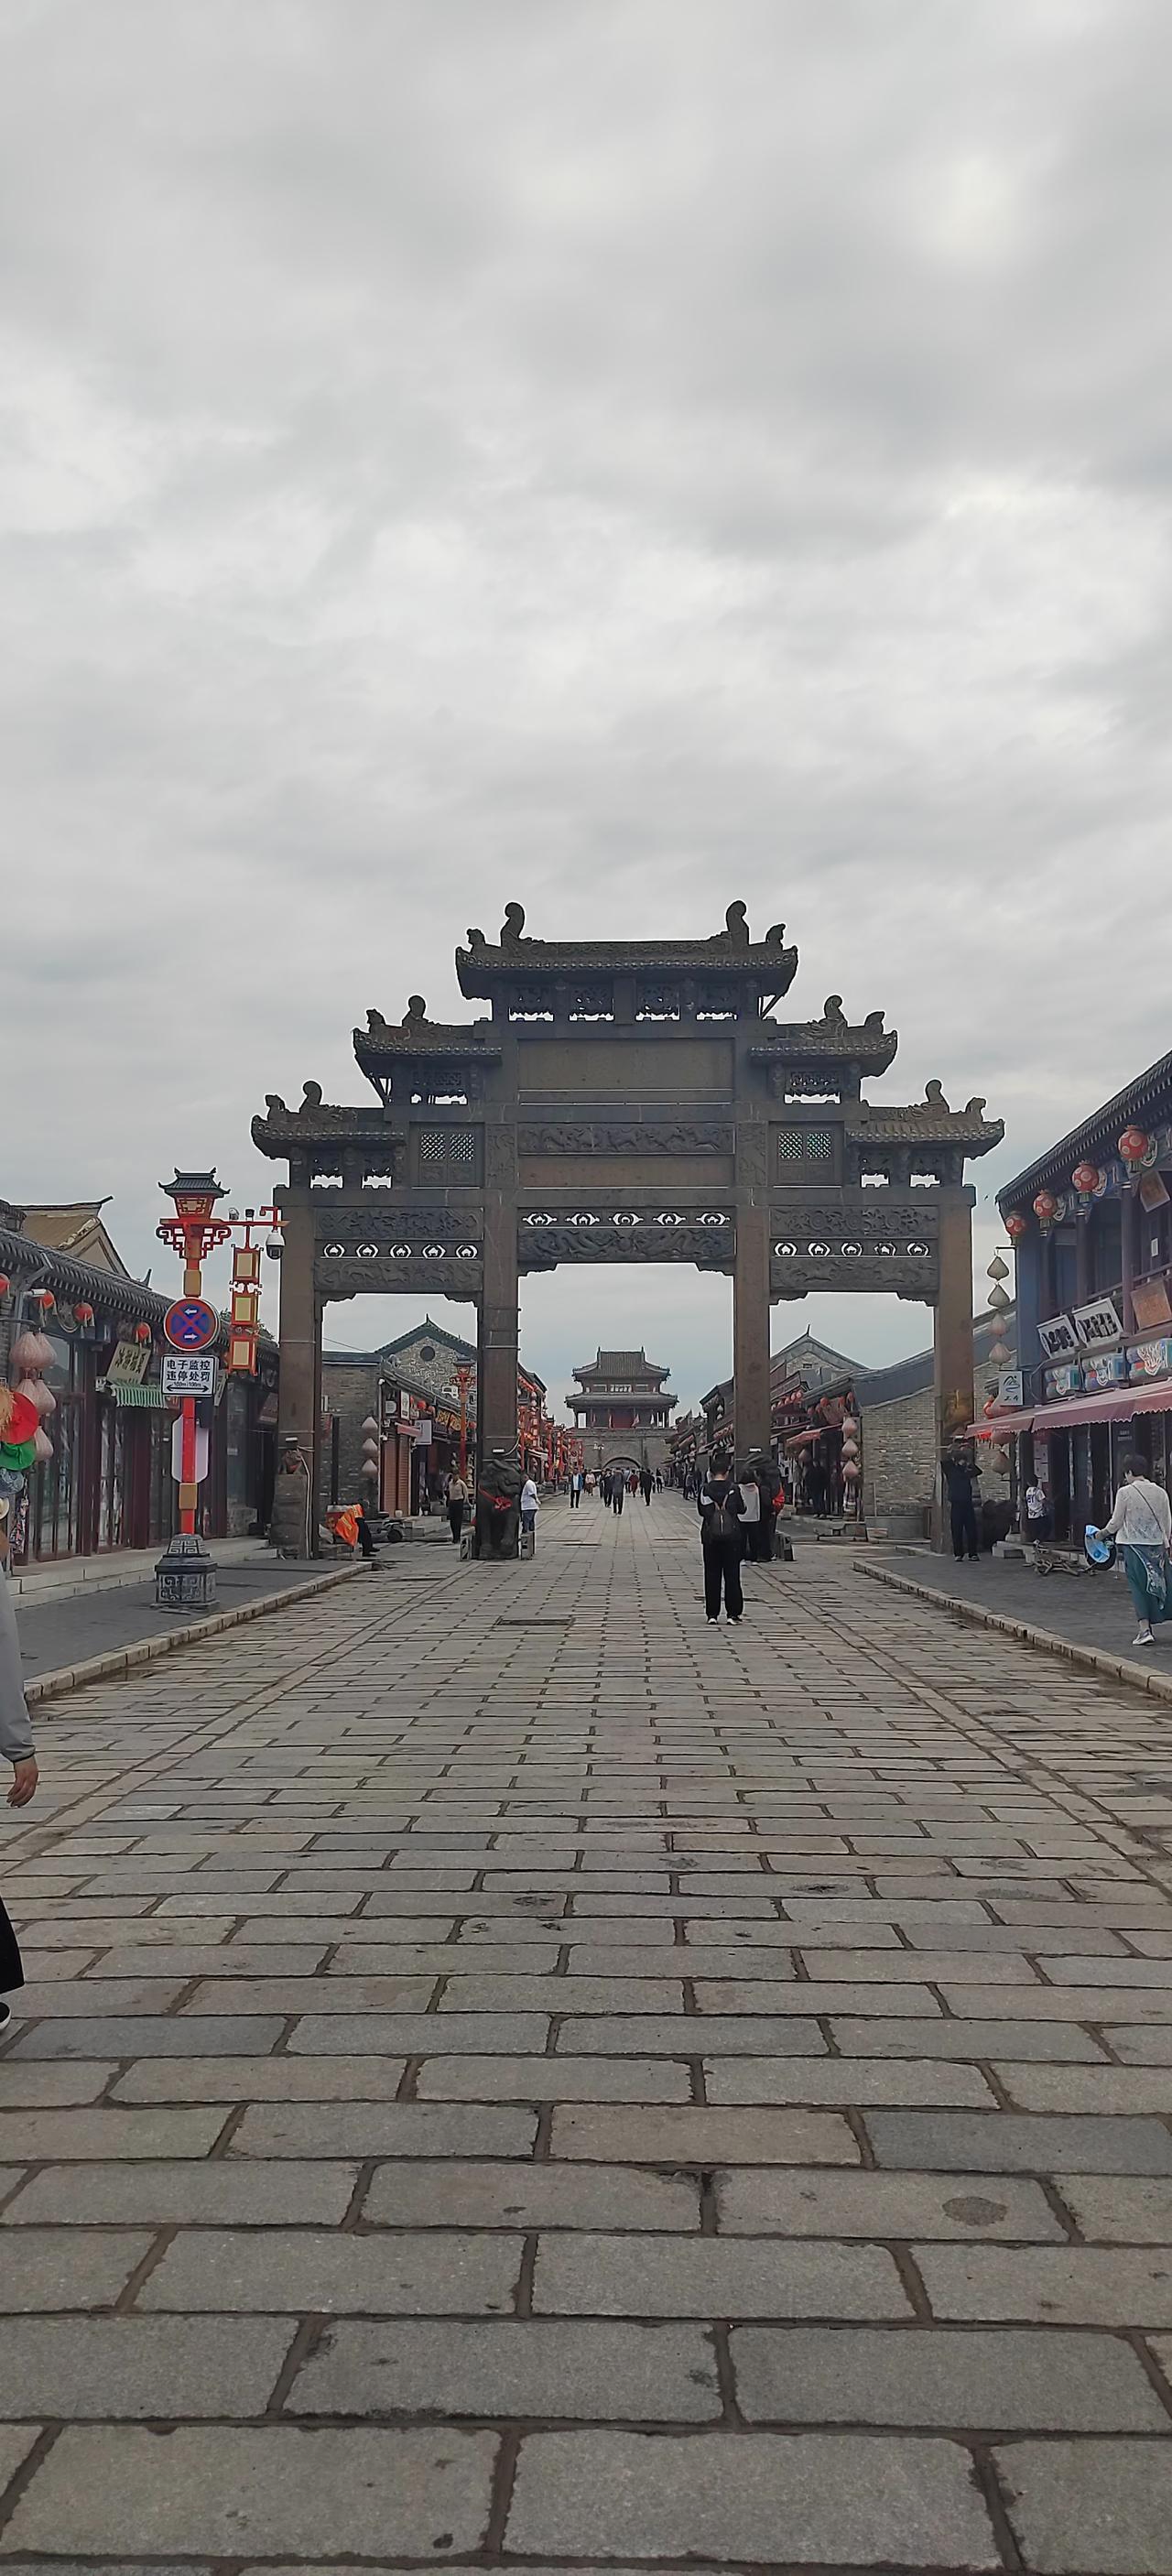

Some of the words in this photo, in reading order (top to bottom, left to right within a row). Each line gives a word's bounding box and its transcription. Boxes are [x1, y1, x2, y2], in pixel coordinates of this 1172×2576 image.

[167, 1359, 211, 1371] 电子监控
[167, 1371, 211, 1382] 违停处罚
